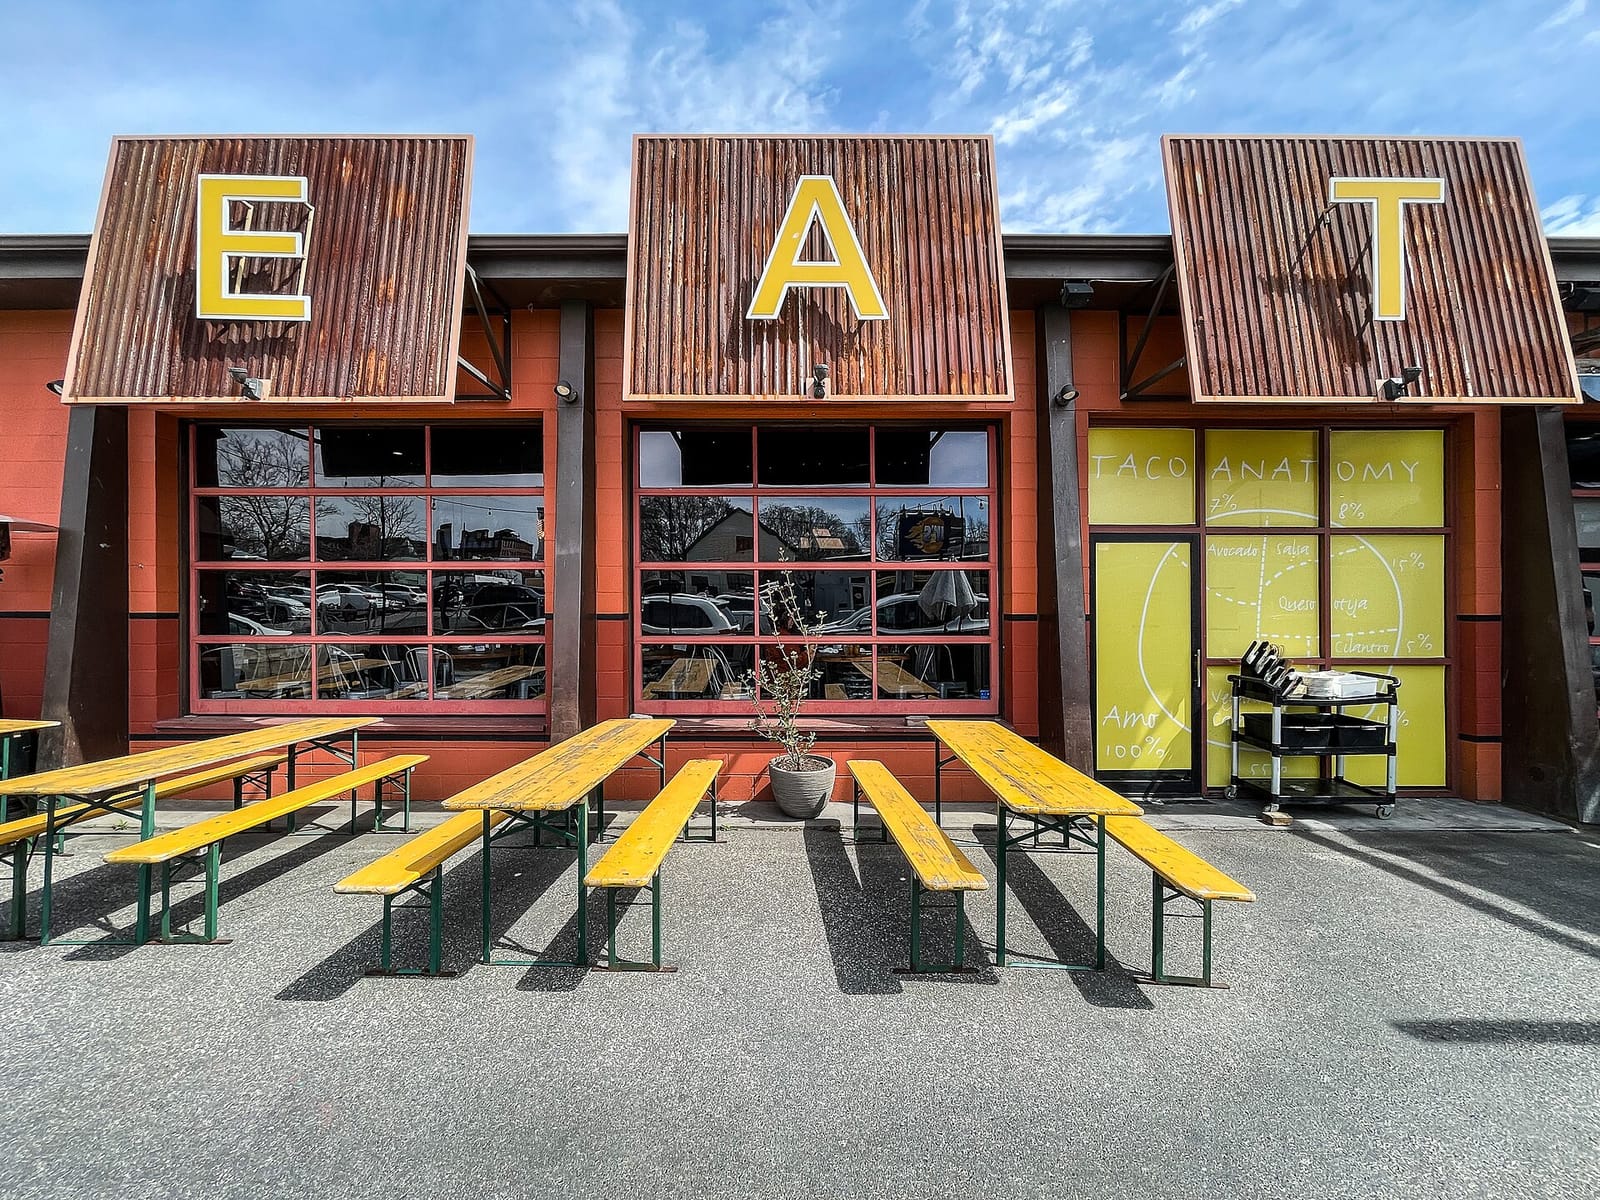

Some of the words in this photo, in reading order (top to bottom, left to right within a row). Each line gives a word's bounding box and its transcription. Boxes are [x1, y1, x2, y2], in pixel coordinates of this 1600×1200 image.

[1091, 453, 1187, 480] TACO
[1209, 494, 1237, 513] 7%
[1338, 502, 1365, 520] 8%
[1207, 543, 1259, 557] Avocado
[1276, 539, 1310, 556] Salsa
[1392, 552, 1425, 573] 15%
[1278, 595, 1317, 612] Queso
[1335, 637, 1390, 654] Cilantro
[1406, 633, 1433, 653] 5%
[1102, 704, 1160, 729] Amo
[1106, 735, 1165, 759] 100%
